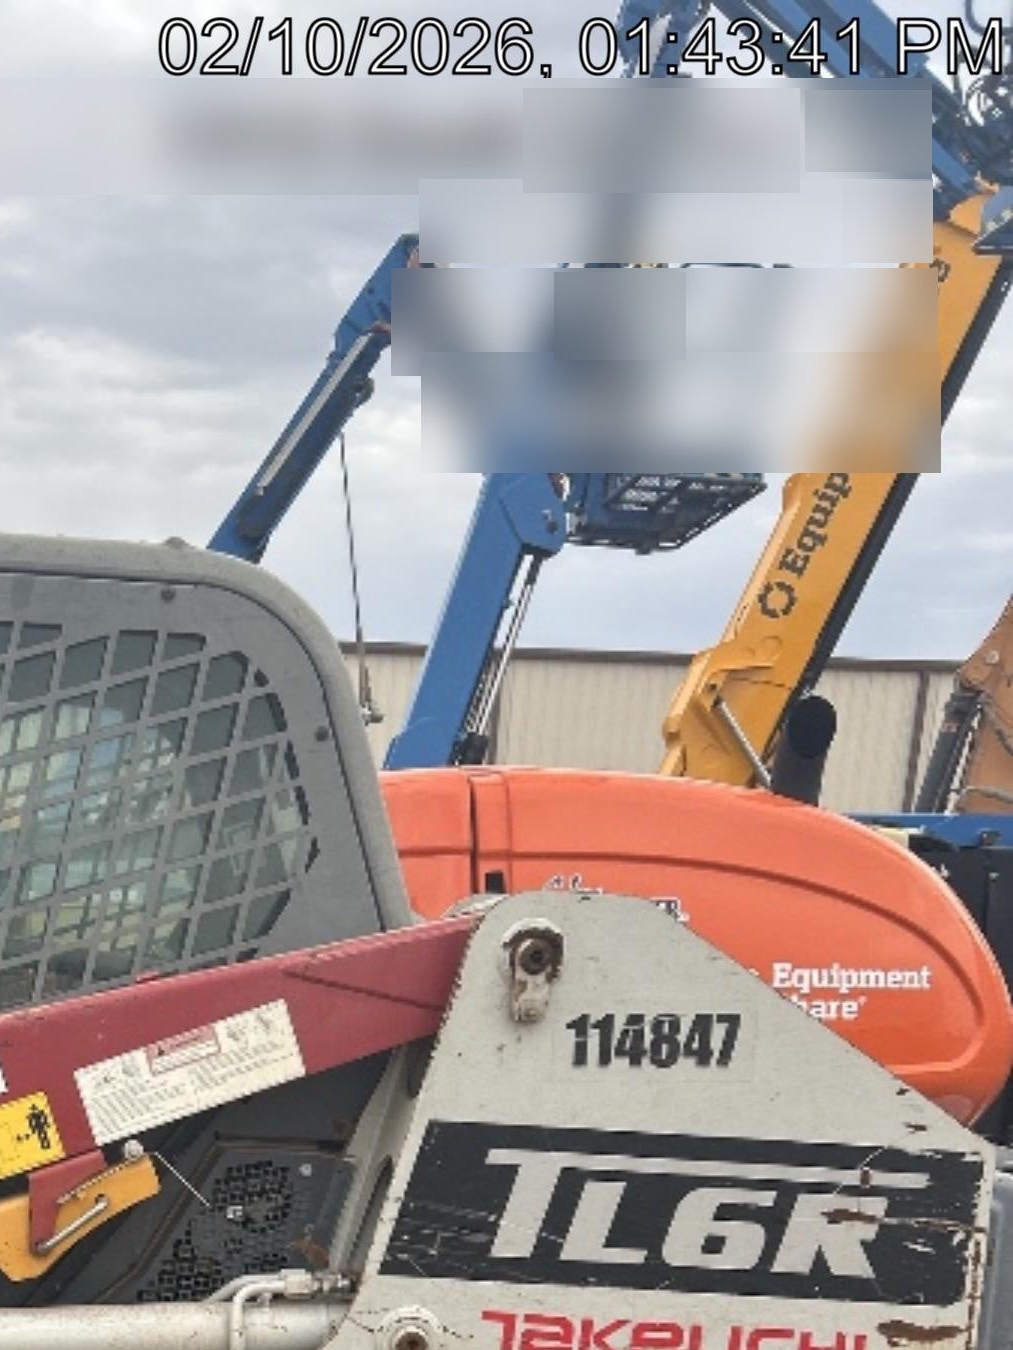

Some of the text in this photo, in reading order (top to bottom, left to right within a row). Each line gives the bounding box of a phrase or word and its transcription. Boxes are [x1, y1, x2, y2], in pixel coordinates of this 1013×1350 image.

[772, 961, 931, 993] Equipment
[789, 993, 859, 1020] hare
[566, 1012, 741, 1069] 114847
[485, 1148, 931, 1280] TL6R
